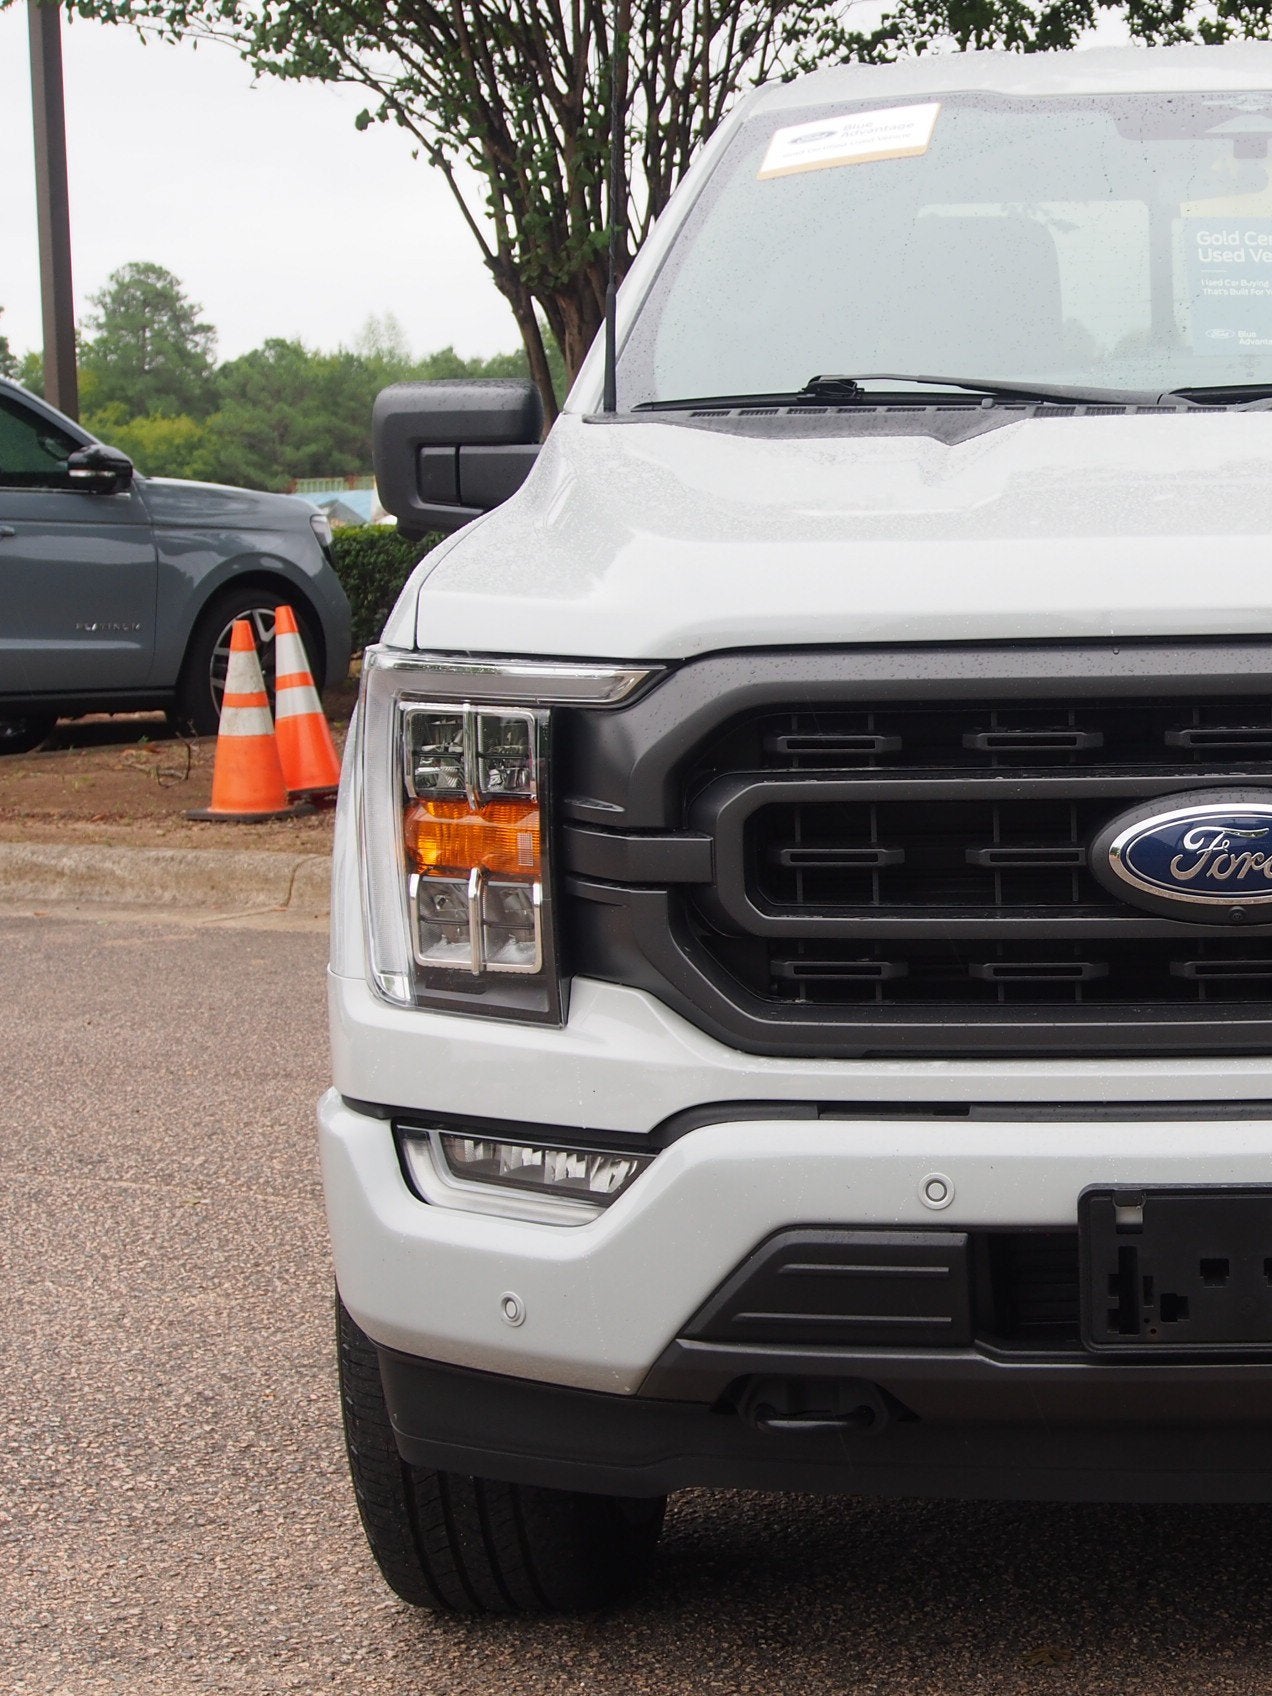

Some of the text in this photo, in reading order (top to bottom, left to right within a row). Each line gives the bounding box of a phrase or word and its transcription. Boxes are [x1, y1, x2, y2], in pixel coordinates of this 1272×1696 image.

[1196, 230, 1240, 245] Gold
[1198, 248, 1246, 263] Used
[1201, 279, 1223, 287] Used
[1240, 279, 1270, 289] Buying
[1203, 288, 1229, 296] That's
[1229, 288, 1249, 296] Built
[1250, 288, 1264, 296] For
[1238, 330, 1257, 338] Blue
